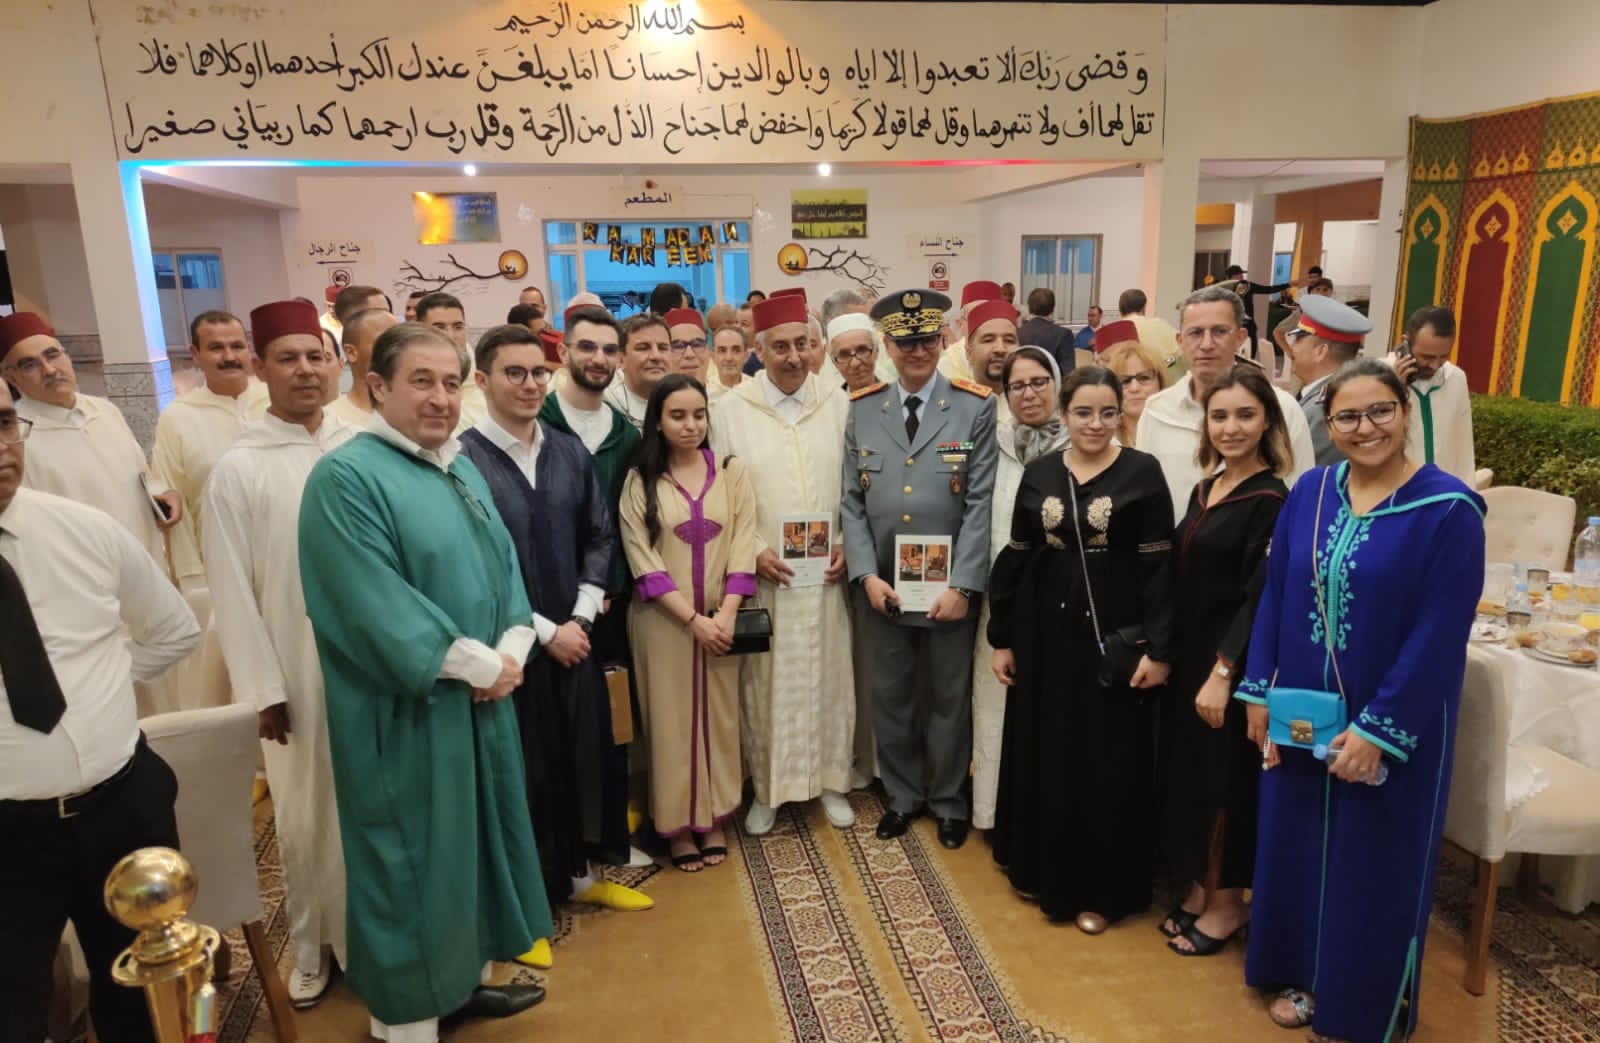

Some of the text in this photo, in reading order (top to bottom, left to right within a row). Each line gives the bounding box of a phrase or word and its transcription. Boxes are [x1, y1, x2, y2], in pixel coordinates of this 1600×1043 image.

[577, 3, 640, 40] الرحمن
[643, 4, 684, 31] الله
[673, 15, 745, 36] بسم
[137, 38, 177, 75] فلا
[262, 32, 344, 80] أحدهما
[336, 37, 394, 92] الكبر
[707, 44, 831, 95] وبالوالدين
[882, 48, 907, 88] إلا
[913, 50, 989, 95] تعبدوا
[997, 45, 1017, 84] ألا
[124, 102, 217, 154] صغيرا
[296, 101, 337, 138] كما
[343, 106, 418, 151] ارحمهما
[425, 120, 467, 154] رب
[471, 103, 514, 151] وقل
[577, 115, 607, 144] من
[872, 101, 907, 151] قولا
[909, 106, 932, 138] لهما
[935, 107, 970, 148] وقل
[972, 107, 1032, 149] تنهرهما
[1037, 104, 1060, 146] ولا
[1063, 100, 1095, 138] أف
[1098, 102, 1124, 138] لهما
[1122, 104, 1155, 146] تقل
[624, 191, 672, 208] المطعم
[308, 241, 360, 257] جناح الرجال
